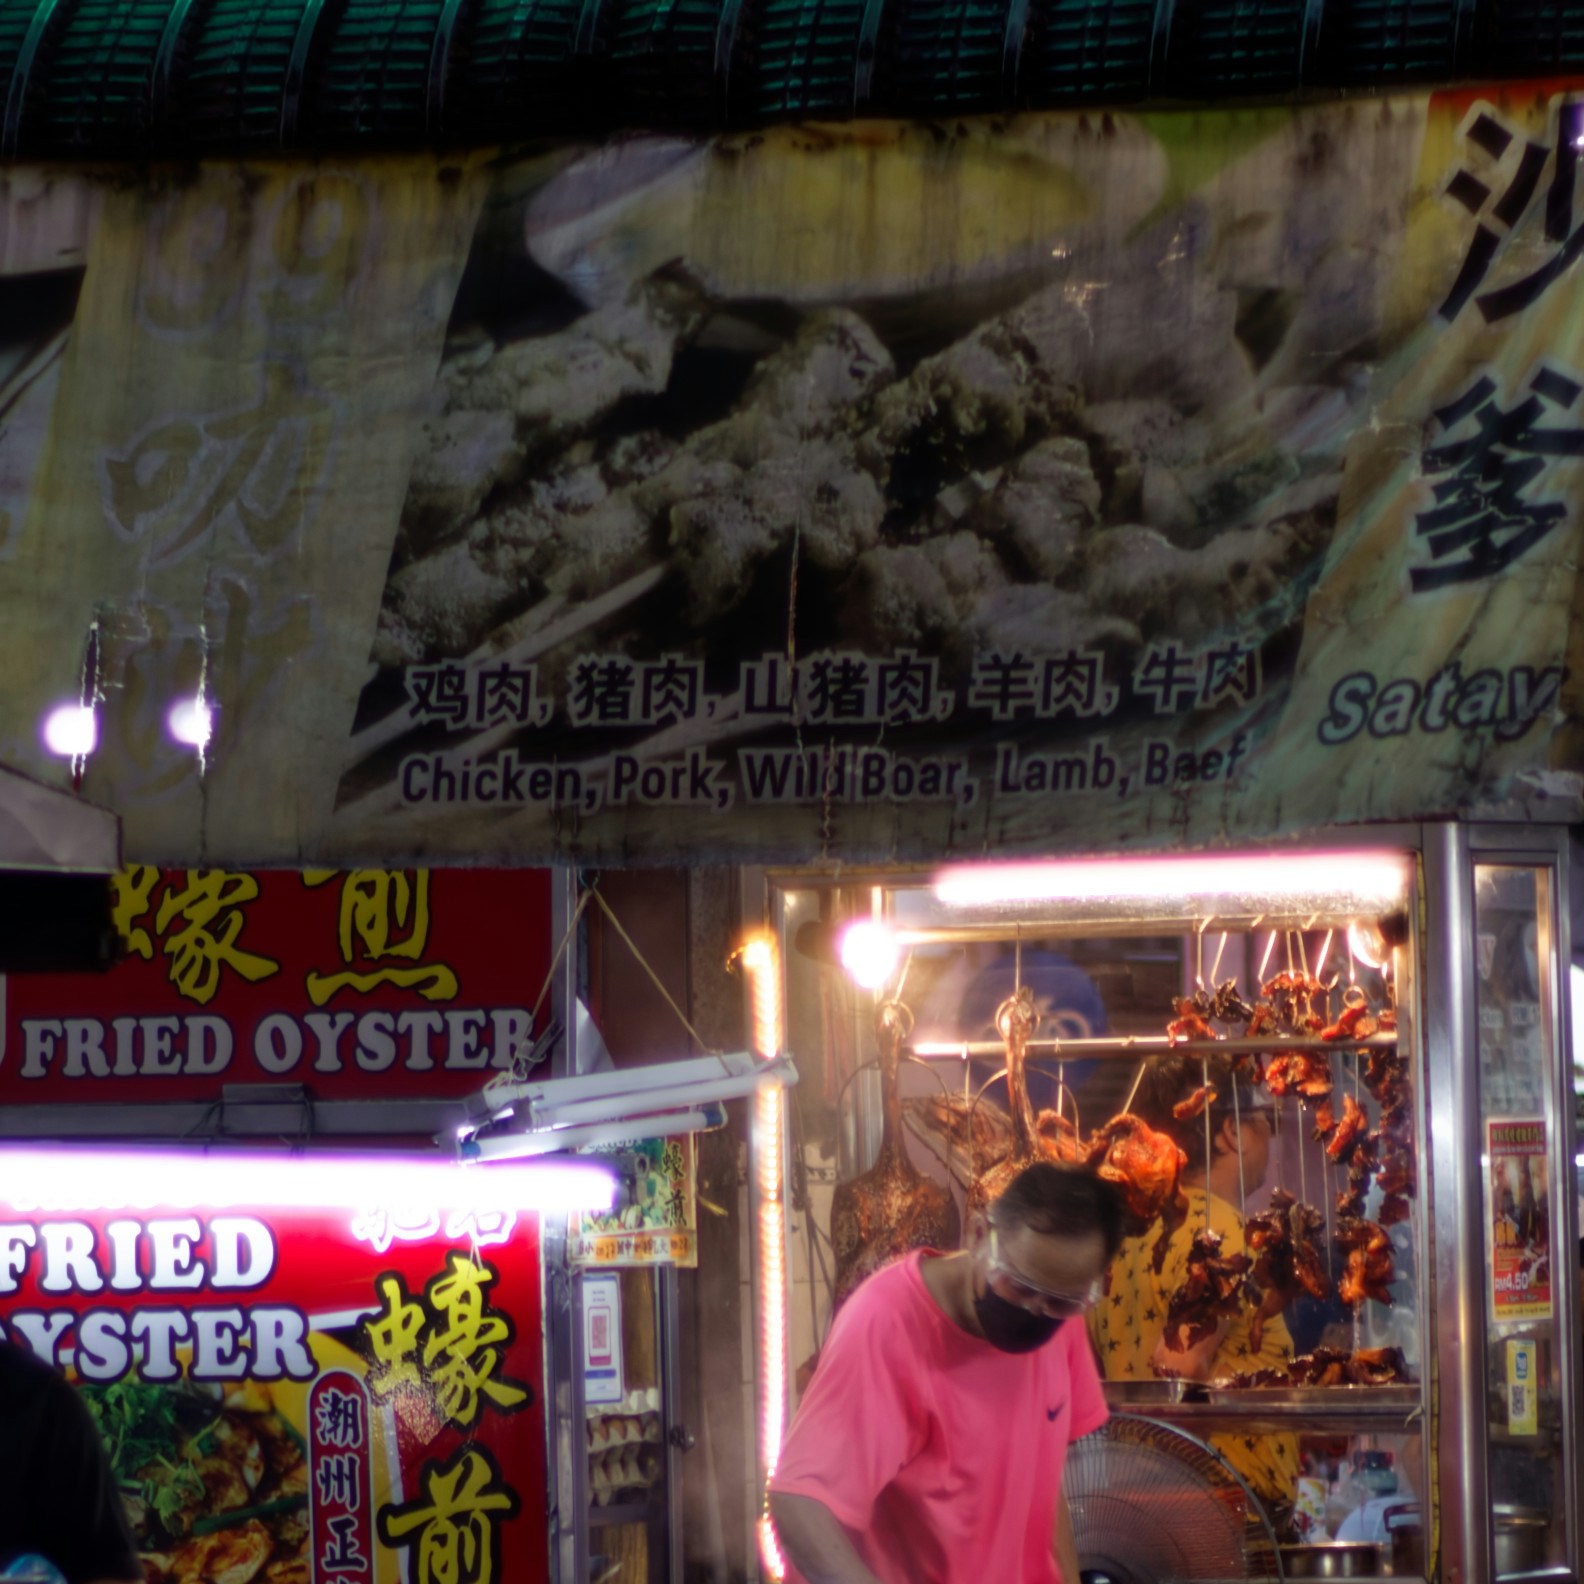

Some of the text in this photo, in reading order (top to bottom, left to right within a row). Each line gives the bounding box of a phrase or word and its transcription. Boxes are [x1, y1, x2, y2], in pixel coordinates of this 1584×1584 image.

[1318, 664, 1567, 746] Satay
[402, 739, 1250, 809] Chicken, Pork, Wild Boar, Lamb, Beef
[19, 1008, 532, 1079] FRIED OYSTER
